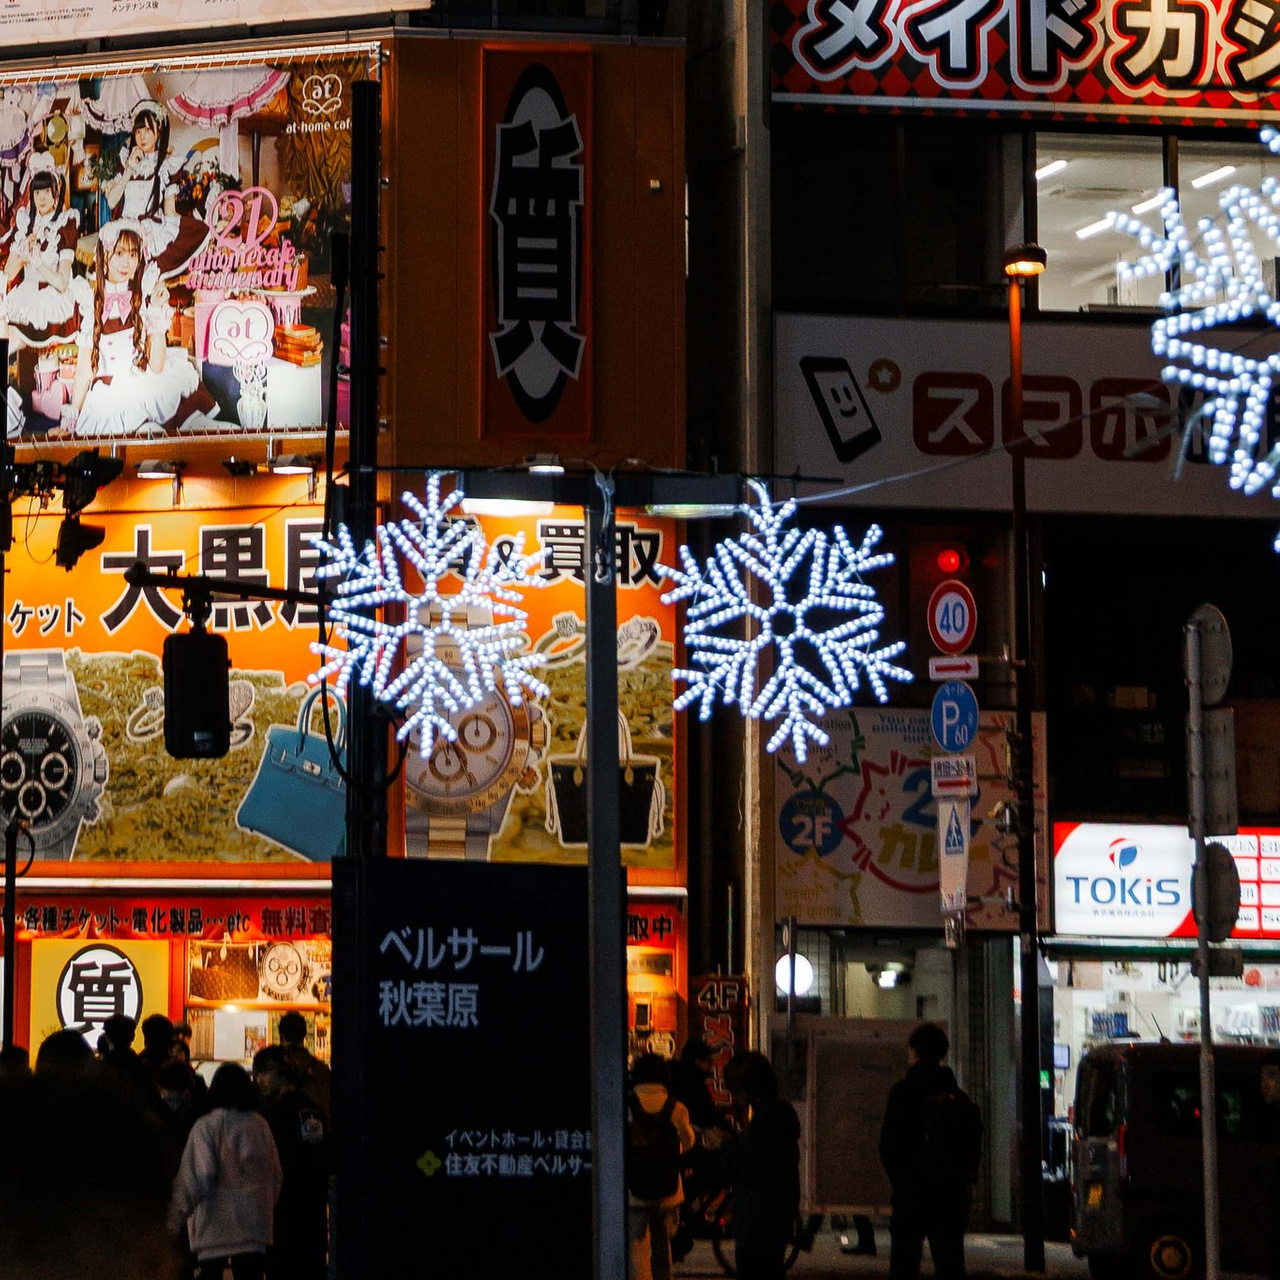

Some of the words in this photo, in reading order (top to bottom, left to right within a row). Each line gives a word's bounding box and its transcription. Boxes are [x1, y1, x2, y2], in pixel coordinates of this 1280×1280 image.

[220, 194, 263, 248] 21
[939, 602, 966, 635] 40
[942, 700, 960, 747] P
[955, 724, 969, 746] 60
[790, 813, 832, 846] 2F
[379, 925, 546, 974] ベルサール
[67, 959, 134, 1041] 質
[378, 980, 480, 1029] 秋葉原
[698, 981, 740, 1012] 4F
